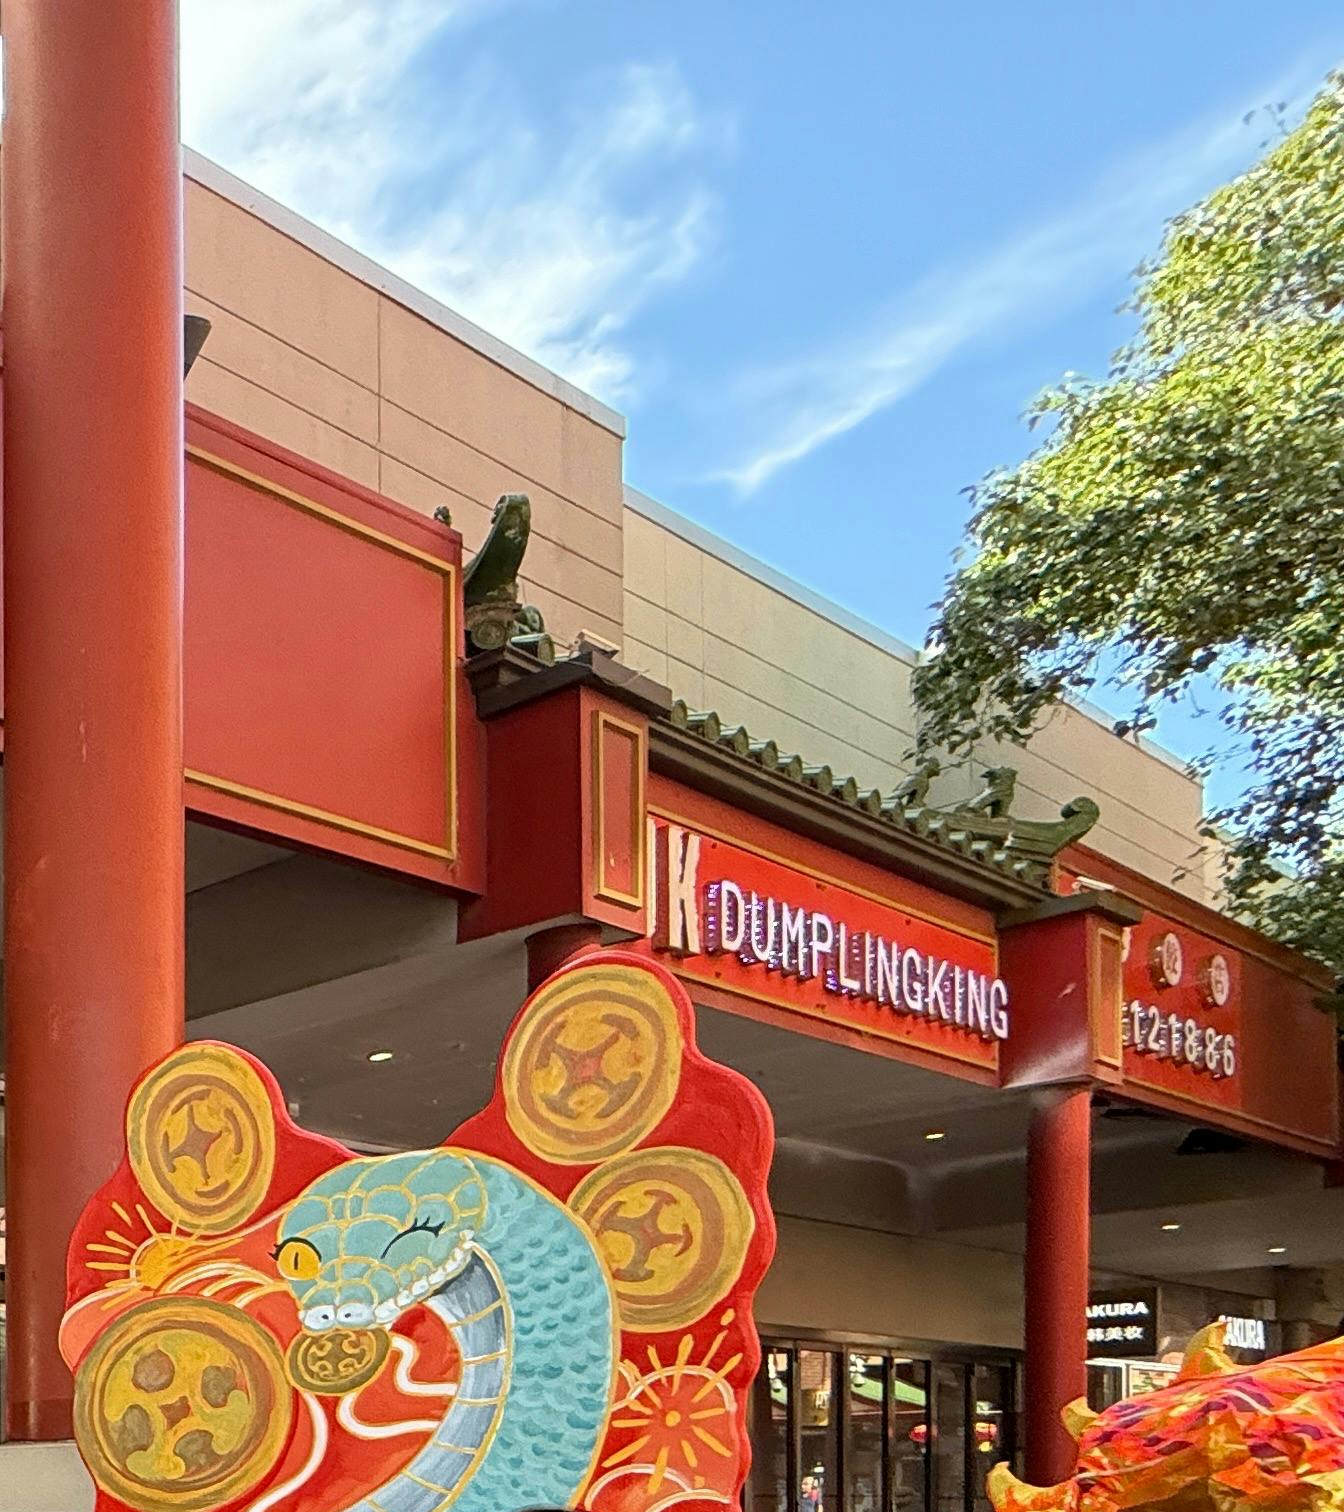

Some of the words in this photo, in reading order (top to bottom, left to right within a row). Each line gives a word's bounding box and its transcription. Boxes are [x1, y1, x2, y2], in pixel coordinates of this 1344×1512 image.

[647, 818, 702, 955] K
[720, 880, 1009, 1040] DUMPLINGKING
[1219, 1315, 1266, 1350] AKURA
